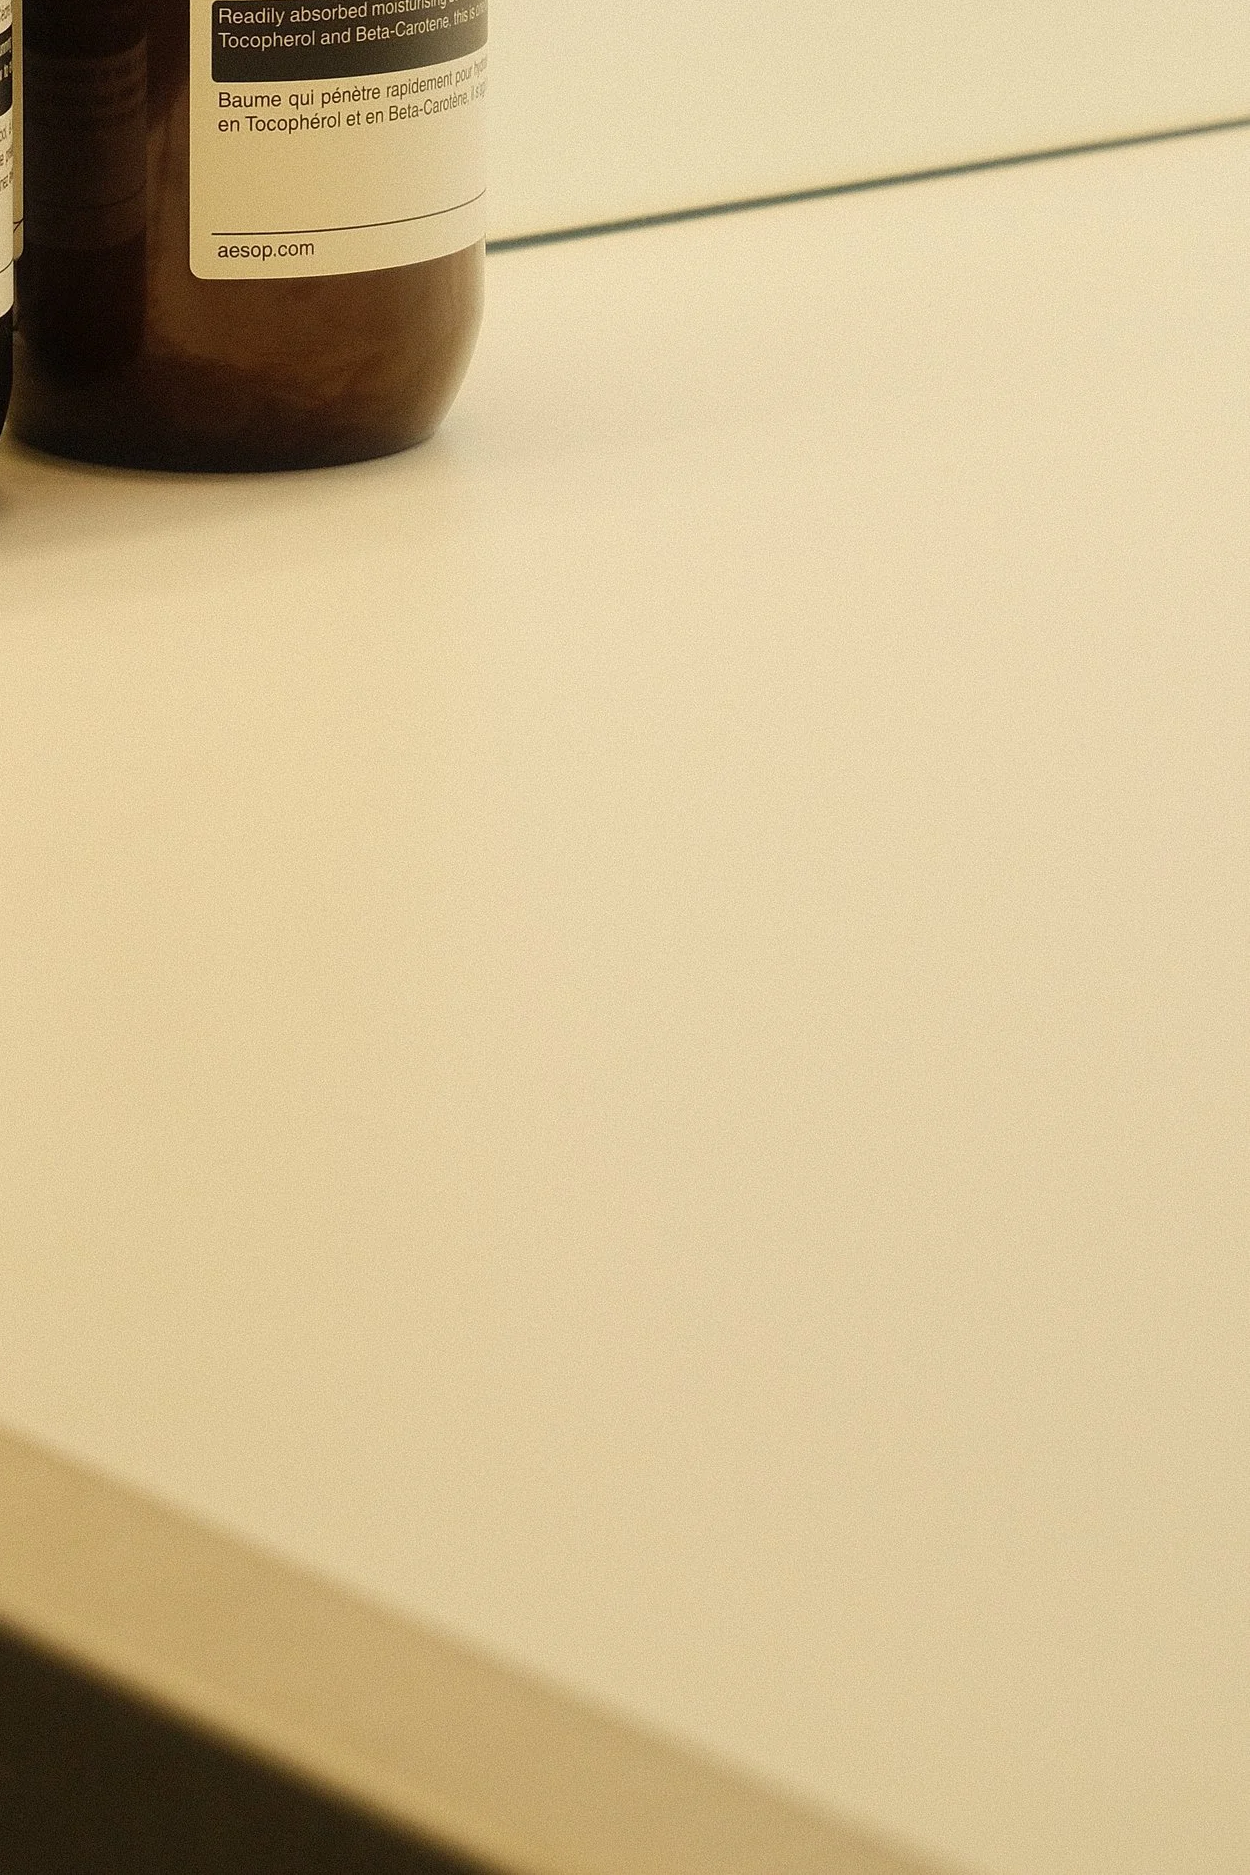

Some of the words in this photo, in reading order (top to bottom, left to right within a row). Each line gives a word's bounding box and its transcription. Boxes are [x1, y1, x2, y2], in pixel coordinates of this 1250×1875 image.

[218, 8, 285, 27] Readily
[290, 2, 368, 21] absorbed
[218, 31, 316, 51] Tocopherol
[321, 27, 351, 44] and
[454, 11, 468, 25] this
[218, 93, 282, 109] Baume
[288, 90, 315, 109] qui
[321, 85, 380, 108] pénètre
[386, 71, 452, 100] rapidement
[455, 64, 473, 86] pour
[218, 118, 240, 132] en
[245, 112, 341, 134] Tocophérol
[346, 109, 361, 126] et
[366, 108, 384, 124] en
[217, 241, 315, 260] aesop.com
